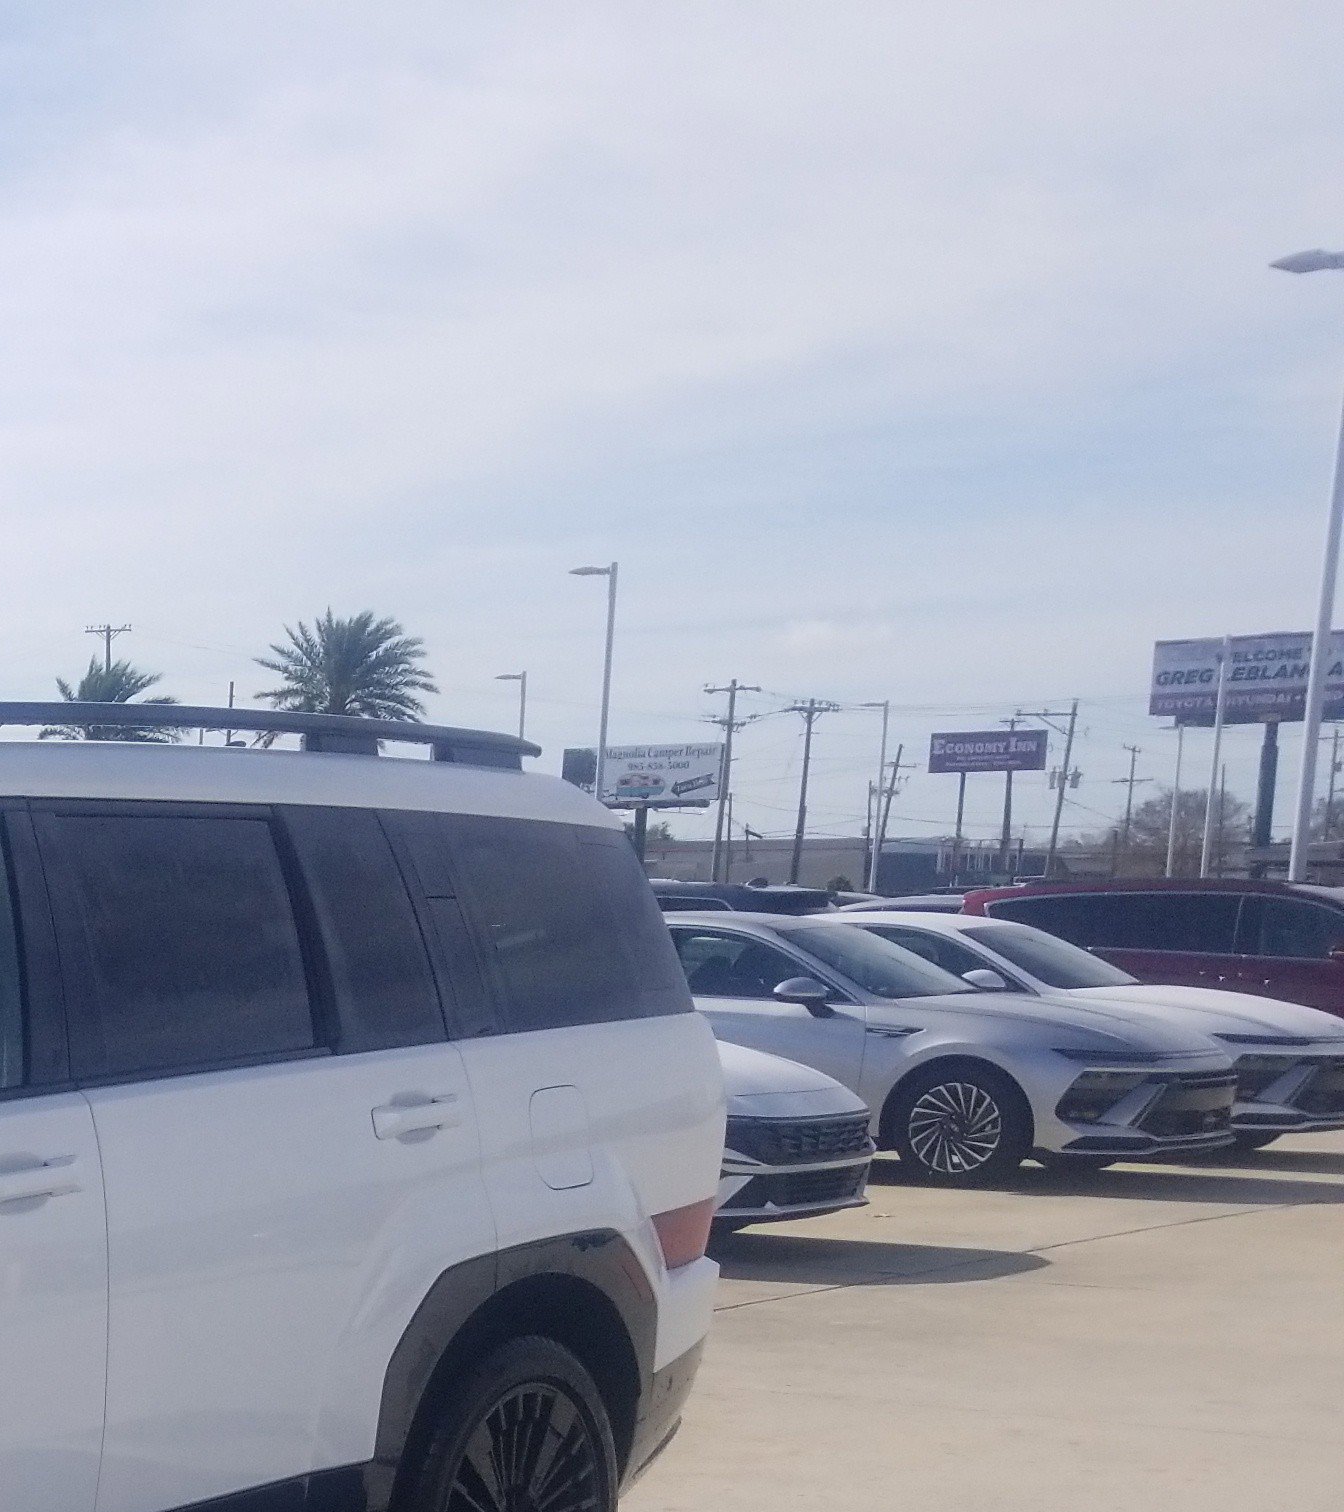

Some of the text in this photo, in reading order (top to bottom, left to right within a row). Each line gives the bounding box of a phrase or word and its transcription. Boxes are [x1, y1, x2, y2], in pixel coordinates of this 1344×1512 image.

[1156, 668, 1215, 686] GREG
[1218, 662, 1311, 683] EBLAN
[932, 737, 1039, 755] ECONOMY INN
